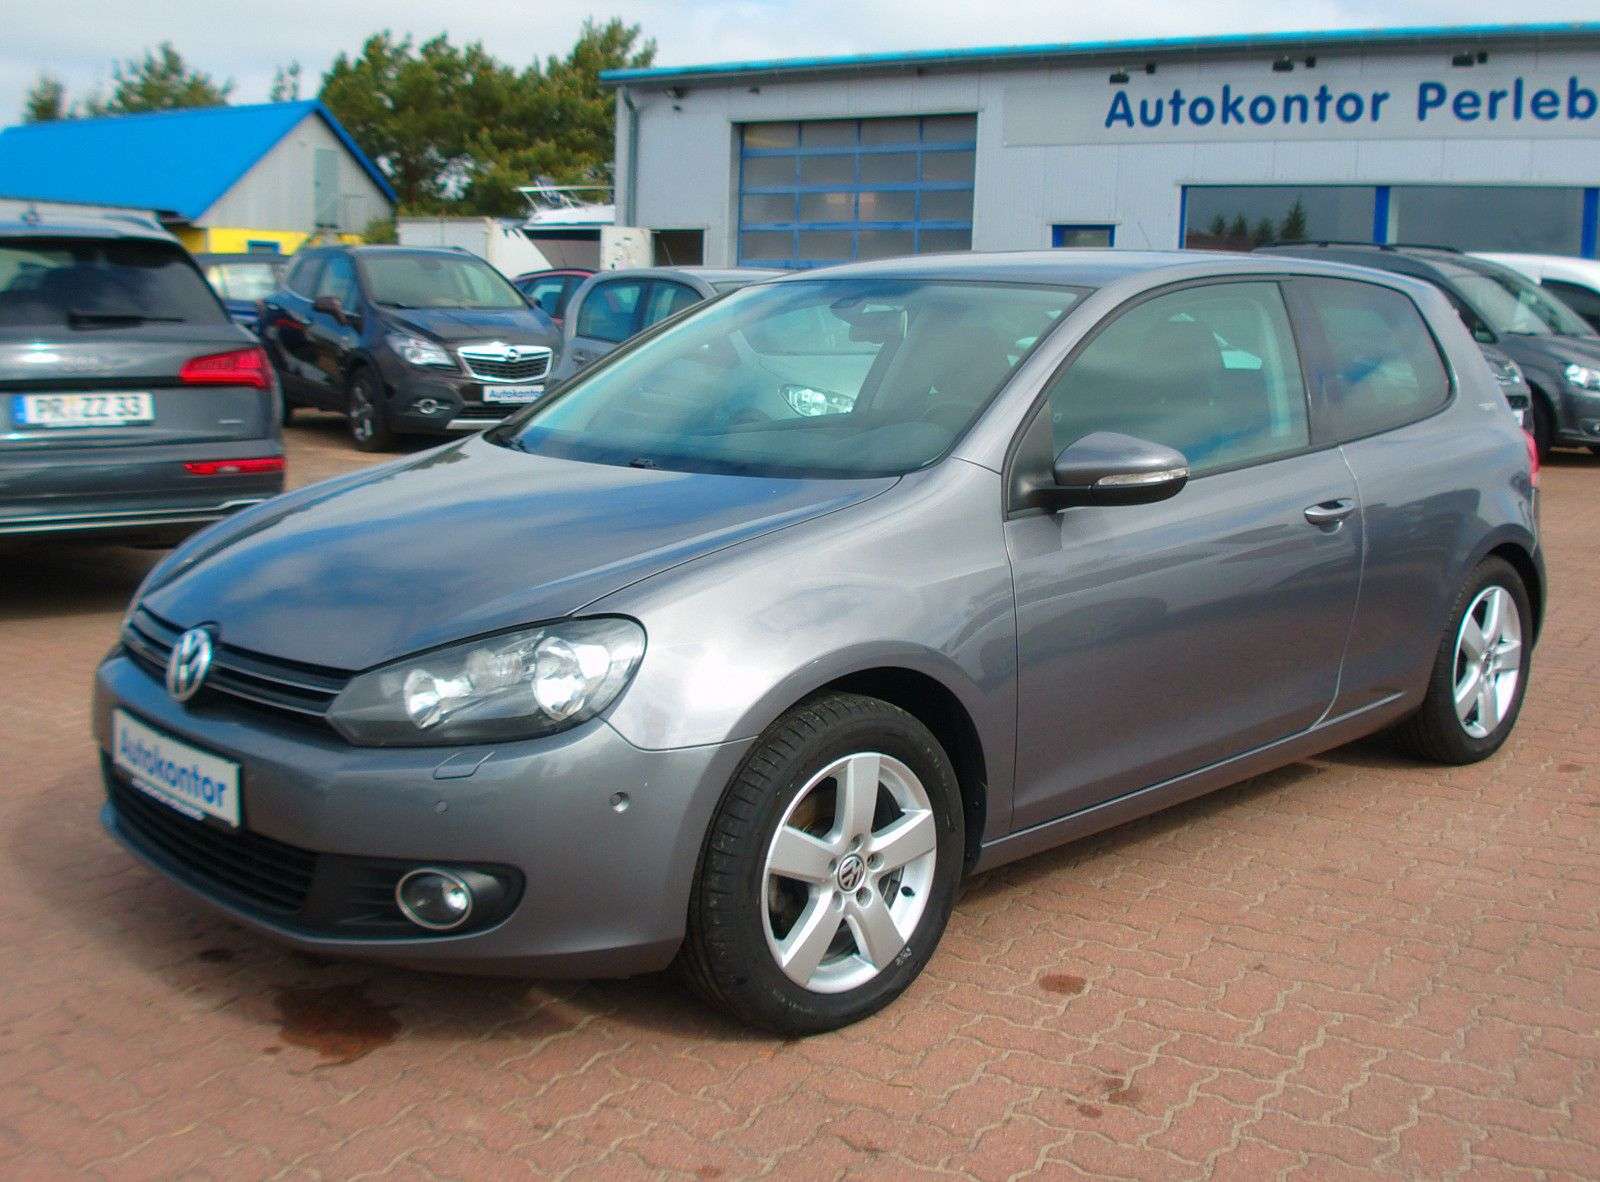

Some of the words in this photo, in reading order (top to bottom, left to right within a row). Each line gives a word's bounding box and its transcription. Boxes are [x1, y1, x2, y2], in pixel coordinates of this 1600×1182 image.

[1104, 83, 1391, 128] Autokontor
[1418, 76, 1599, 121] Perleb
[121, 727, 226, 808] Autokontor
